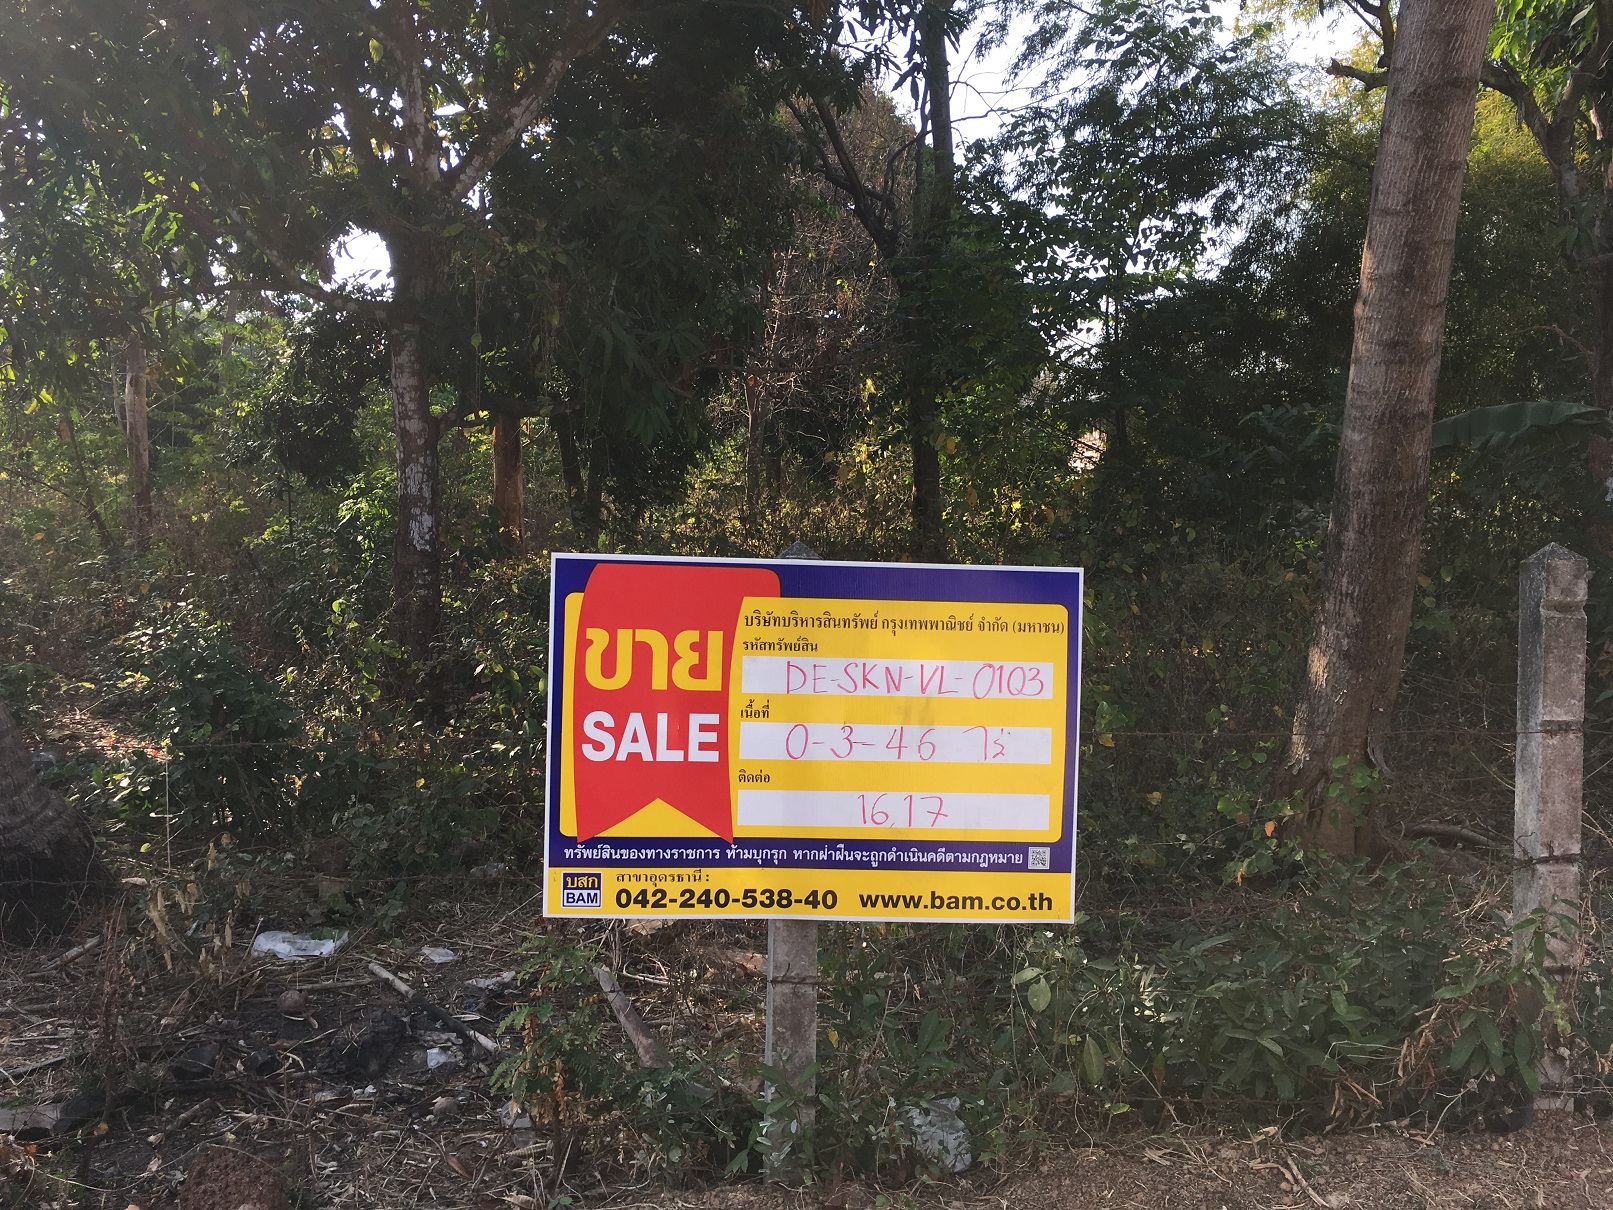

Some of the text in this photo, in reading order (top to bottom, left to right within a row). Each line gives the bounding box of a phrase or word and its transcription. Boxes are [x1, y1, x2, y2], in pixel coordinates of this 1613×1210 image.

[882, 613, 973, 636] กรุงเทพพาณิชย์
[978, 616, 1009, 633] จำกัด
[1013, 619, 1065, 634] (มหาชน)
[743, 636, 818, 652] รหัสทรัพย์สิน
[585, 627, 724, 691] ขาย
[740, 698, 770, 719] เนื้อที่
[581, 711, 720, 762] SALE
[738, 769, 770, 784] ติดต่อ
[564, 844, 1023, 867] ทรัพย์สินของทางราชการ ห้ามบุกรุก หากฝ่าฝืนจะถูกดำเนินคดีตามกฎหมาย
[565, 874, 598, 889] บสก
[566, 892, 599, 904] BAM
[615, 888, 1053, 911] 042-240-538-40 www.bam.co.th
